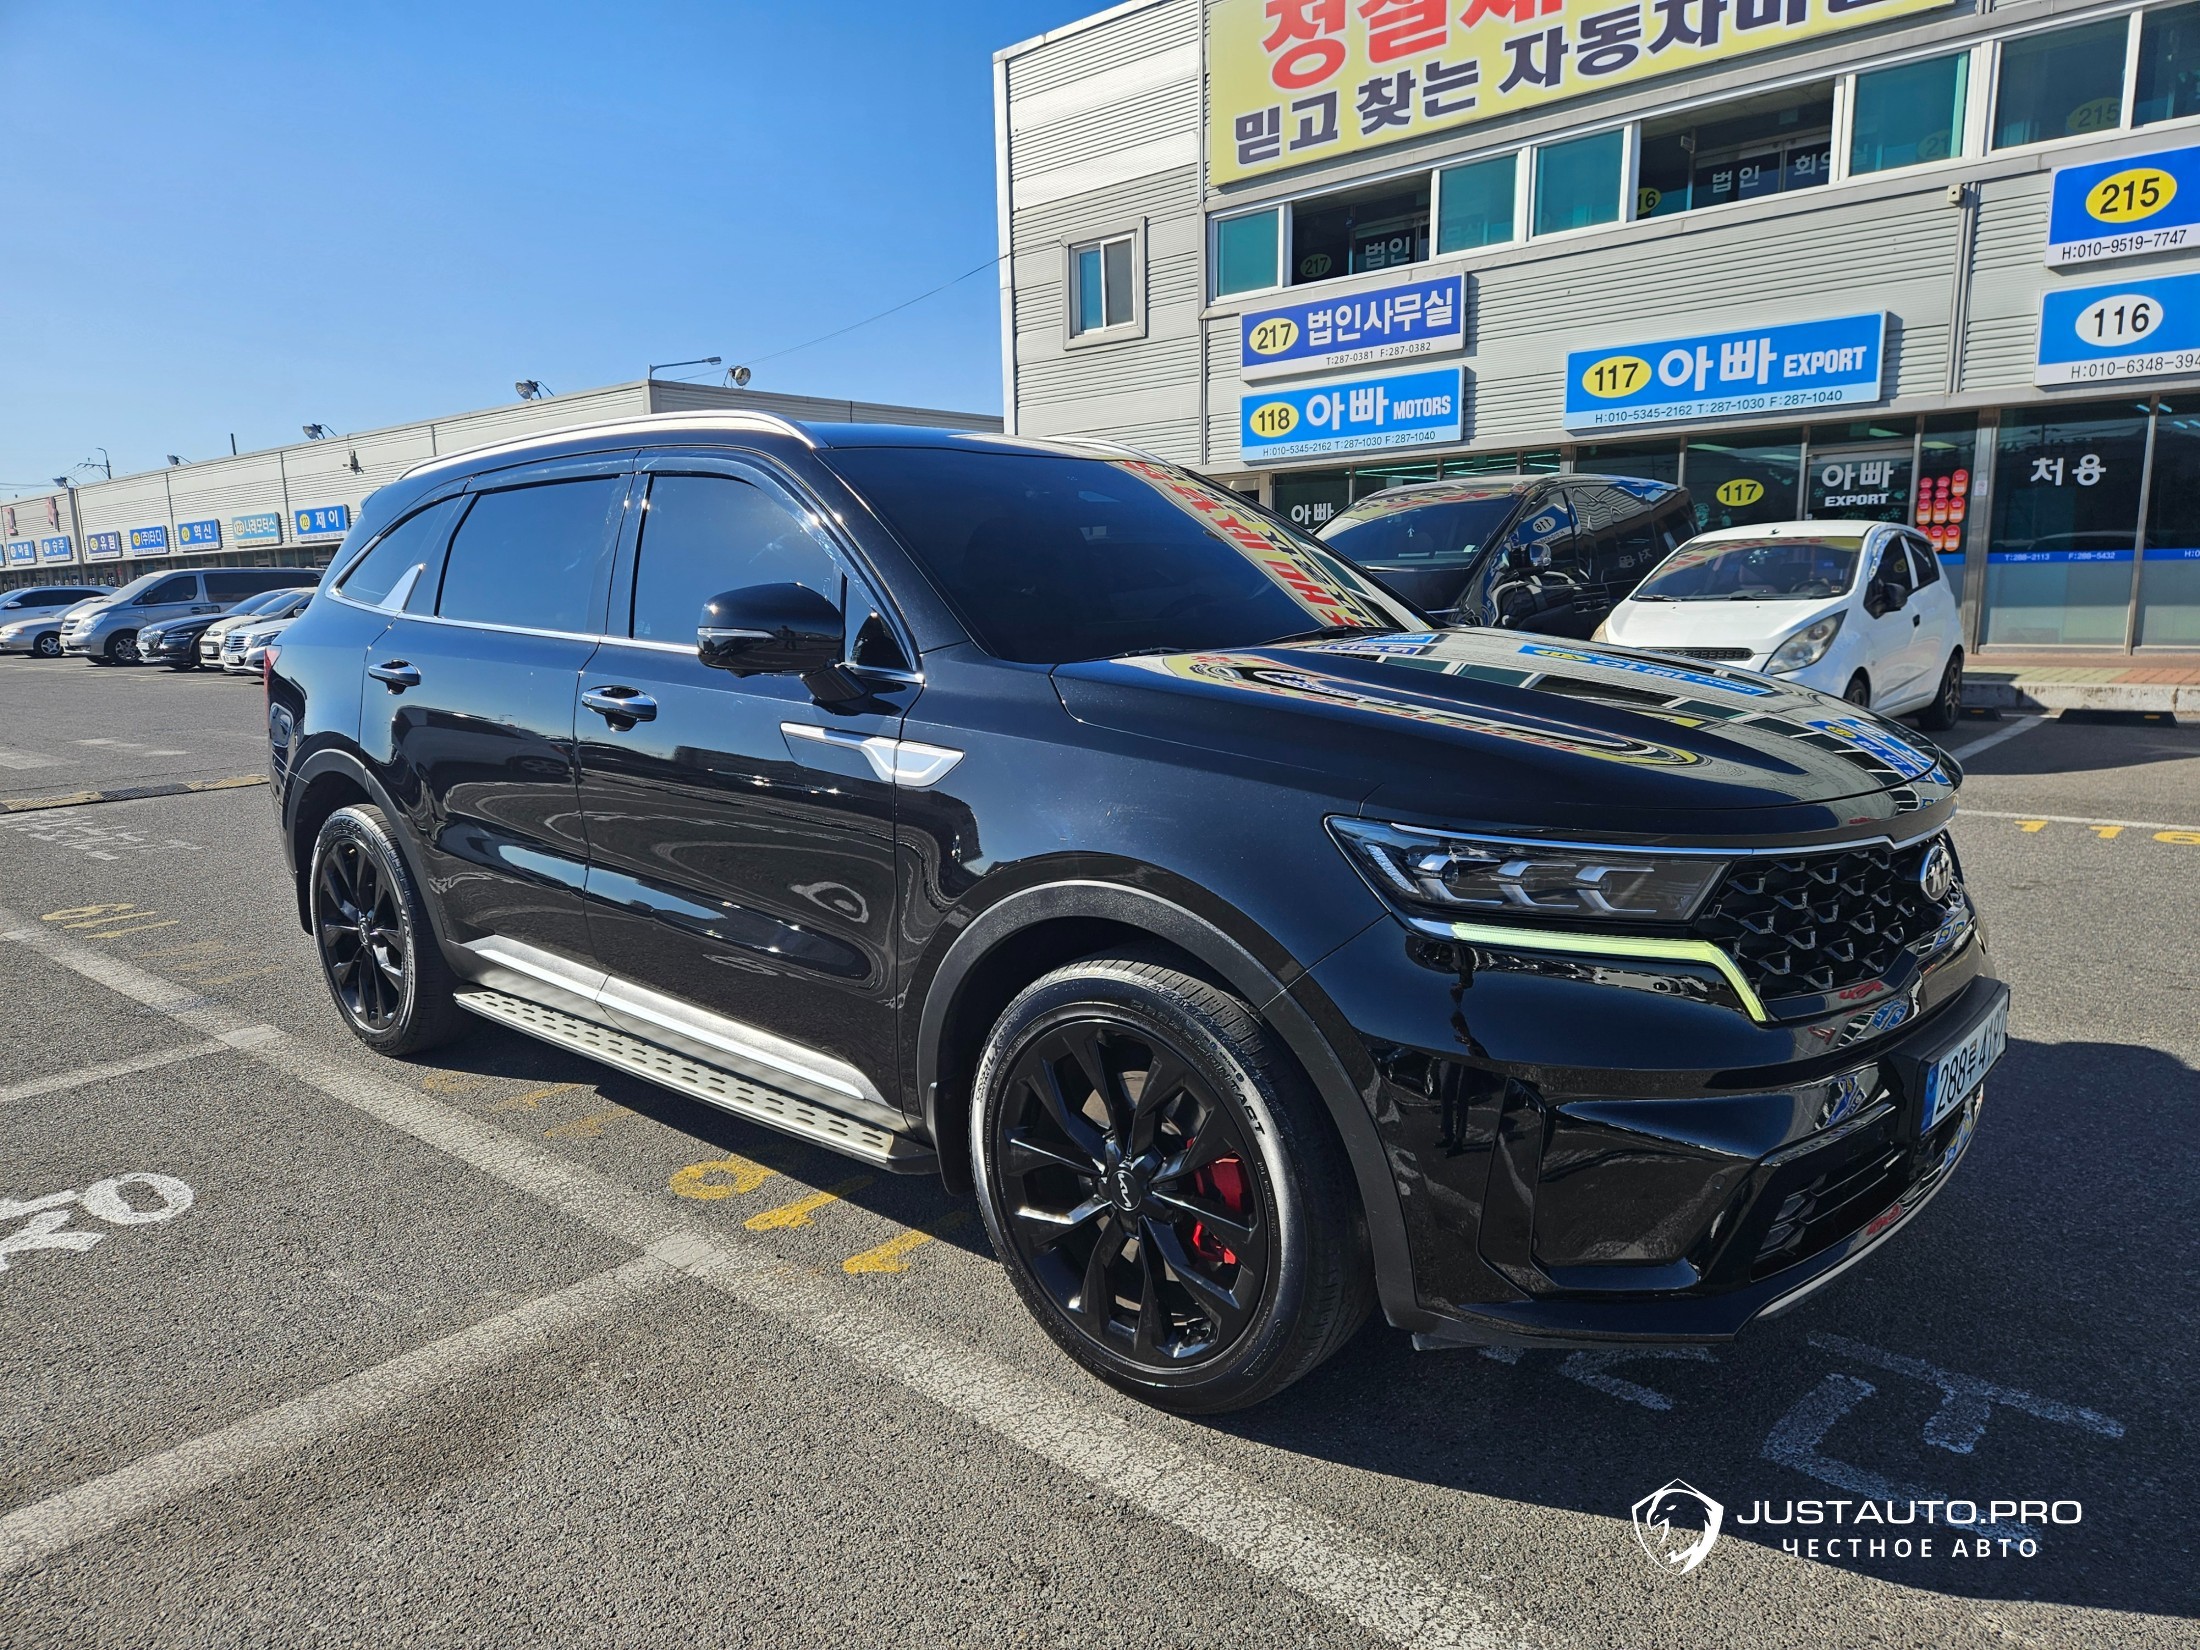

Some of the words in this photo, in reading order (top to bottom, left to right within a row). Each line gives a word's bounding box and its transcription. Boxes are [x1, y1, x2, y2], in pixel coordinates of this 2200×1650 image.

[1235, 90, 1339, 165] 믿고
[1356, 59, 1479, 136] 찾는
[1498, 0, 1886, 94] 자동차
[1712, 164, 1760, 193] 법인
[2099, 176, 2160, 214] 215
[1365, 236, 1411, 269] 법인
[2061, 229, 2187, 261] H:010-9519-7747
[1304, 256, 1329, 275] 217
[1256, 323, 1292, 351] 217
[1307, 287, 1453, 347] 법인사무실
[2094, 302, 2151, 338] 116
[1325, 350, 1374, 366] T:287-0381
[1380, 341, 1431, 358] F:287-0382
[1594, 362, 1639, 392] 117
[1657, 337, 1778, 392] 아빠
[1783, 346, 1867, 378] EXPORT
[1257, 407, 1291, 432] 118
[1305, 386, 1389, 431] 아빠
[1392, 395, 1452, 420] MOTORS
[1595, 404, 1693, 424] H:010-5345-2162
[1696, 397, 1765, 415] T:287-1030
[1770, 389, 1843, 408] F:287-1040
[1262, 441, 1332, 458] H:010-5345-2162
[1335, 436, 1383, 450] T:287-1030
[1385, 430, 1436, 445] F:287-1040
[1821, 460, 1895, 491] 아빠
[2030, 453, 2107, 486] 처용
[1722, 483, 1758, 502] 117
[1824, 493, 1889, 507] EXPORT
[1290, 502, 1335, 525] 아빠
